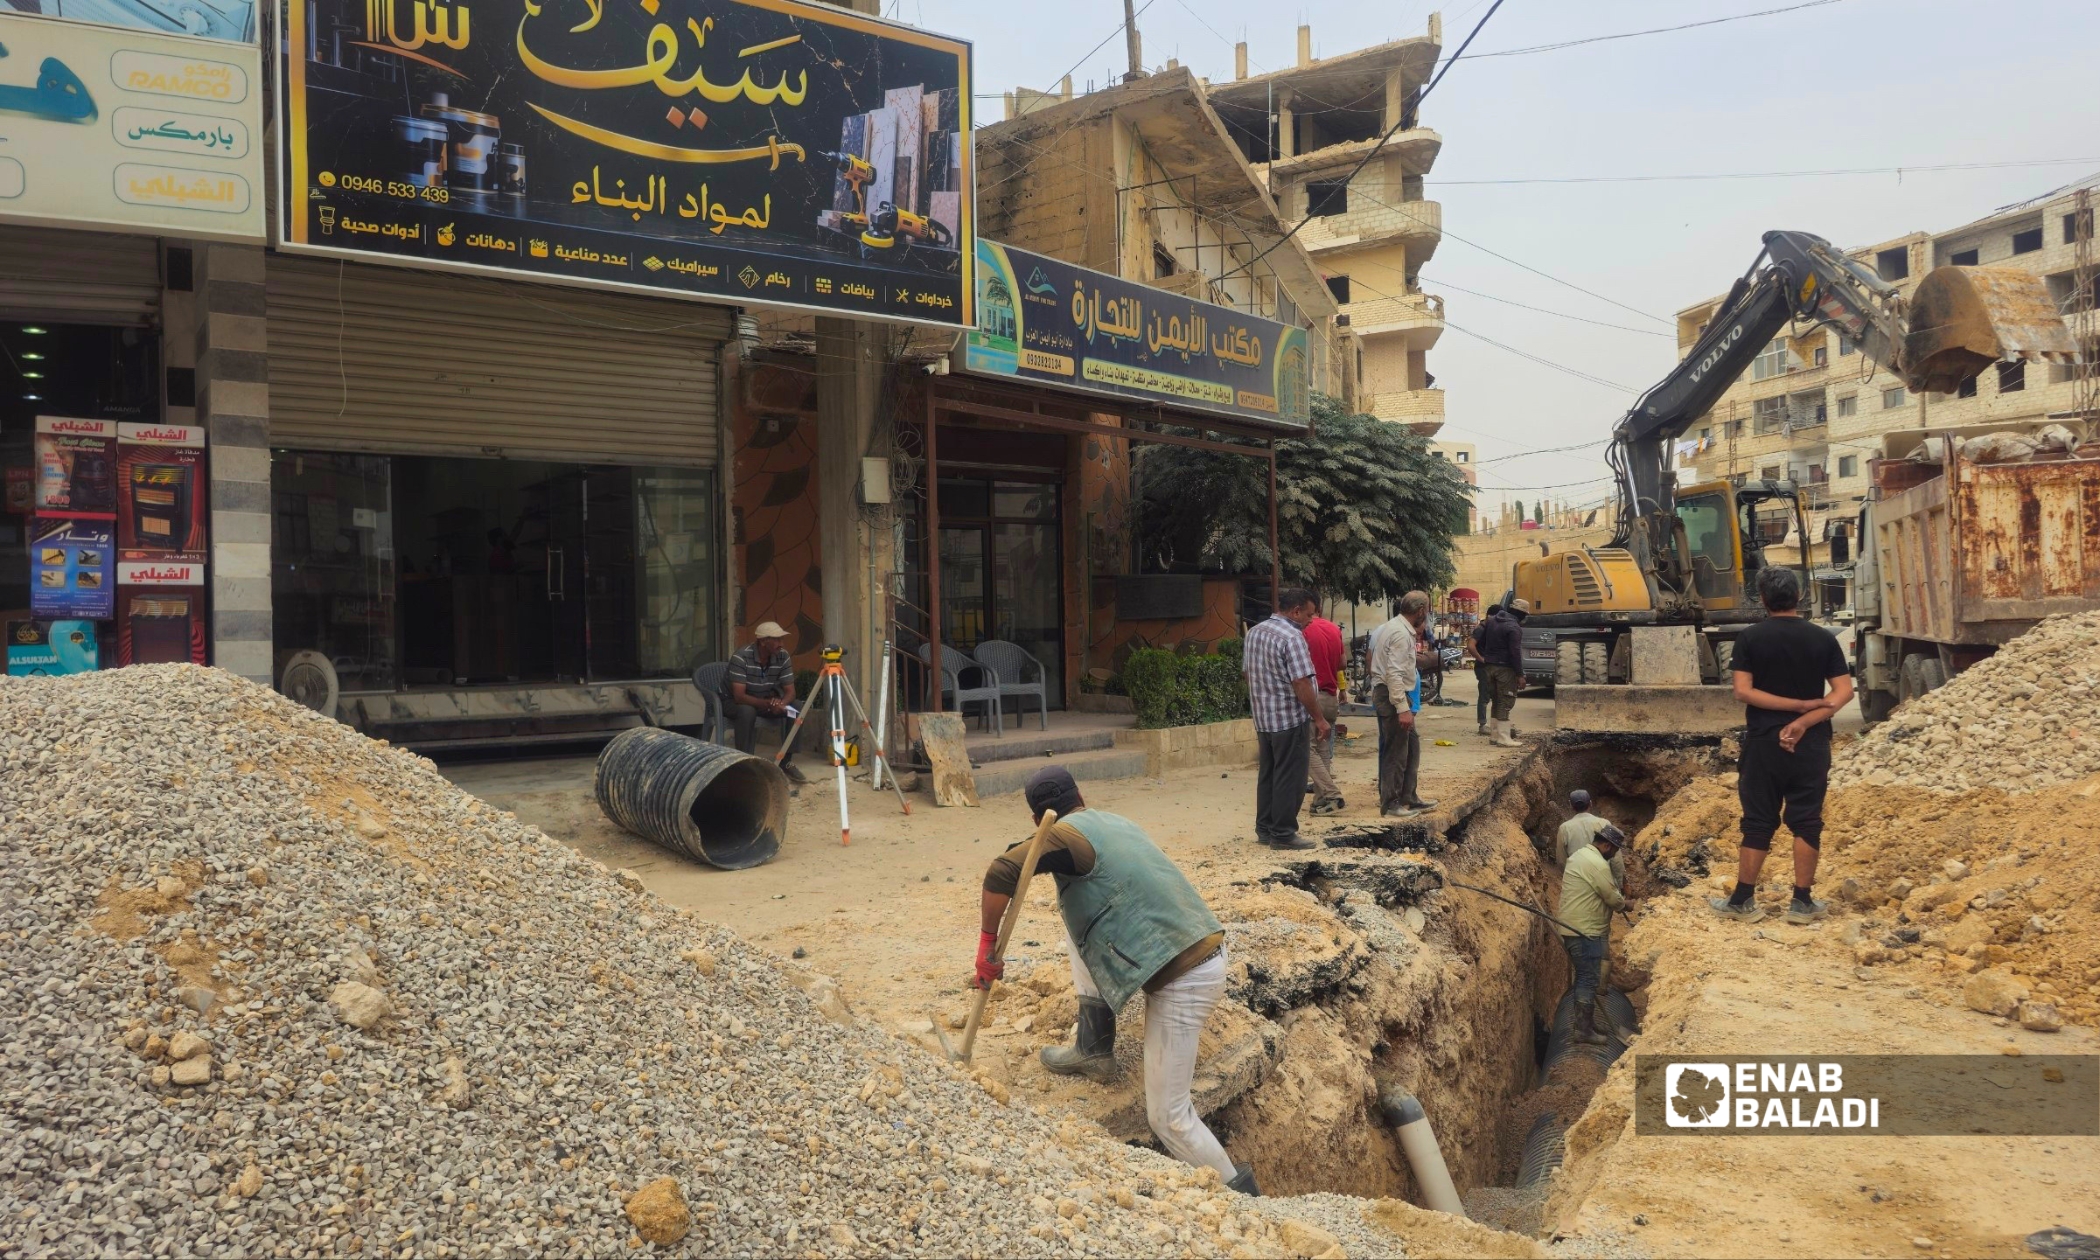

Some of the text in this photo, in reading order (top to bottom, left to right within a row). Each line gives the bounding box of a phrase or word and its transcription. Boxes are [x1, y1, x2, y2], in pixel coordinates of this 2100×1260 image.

[184, 63, 231, 81] رامكو
[127, 71, 231, 98] RAMCO
[128, 121, 234, 150] بارمكس
[129, 174, 235, 202] الشبلي
[341, 175, 449, 204] 0946 533 439
[571, 165, 771, 236] لمواد البناء
[341, 216, 420, 240] أدوات صحية
[466, 234, 516, 252] دهانات
[555, 245, 628, 267] عدد صناعية
[666, 257, 719, 277] سيراميك
[765, 271, 791, 288] رخام
[840, 283, 875, 298] بياضات
[915, 291, 953, 307] خرداوات
[1071, 279, 1262, 370] مكتب الأيمن للتجارة
[1689, 324, 1743, 383] VOLVO
[51, 420, 103, 435] الشبلي
[136, 429, 187, 442] الشبلي
[130, 567, 190, 582] الشبلي
[1535, 563, 1560, 573] VOLVO
[9, 655, 58, 665] ALSULTAN
